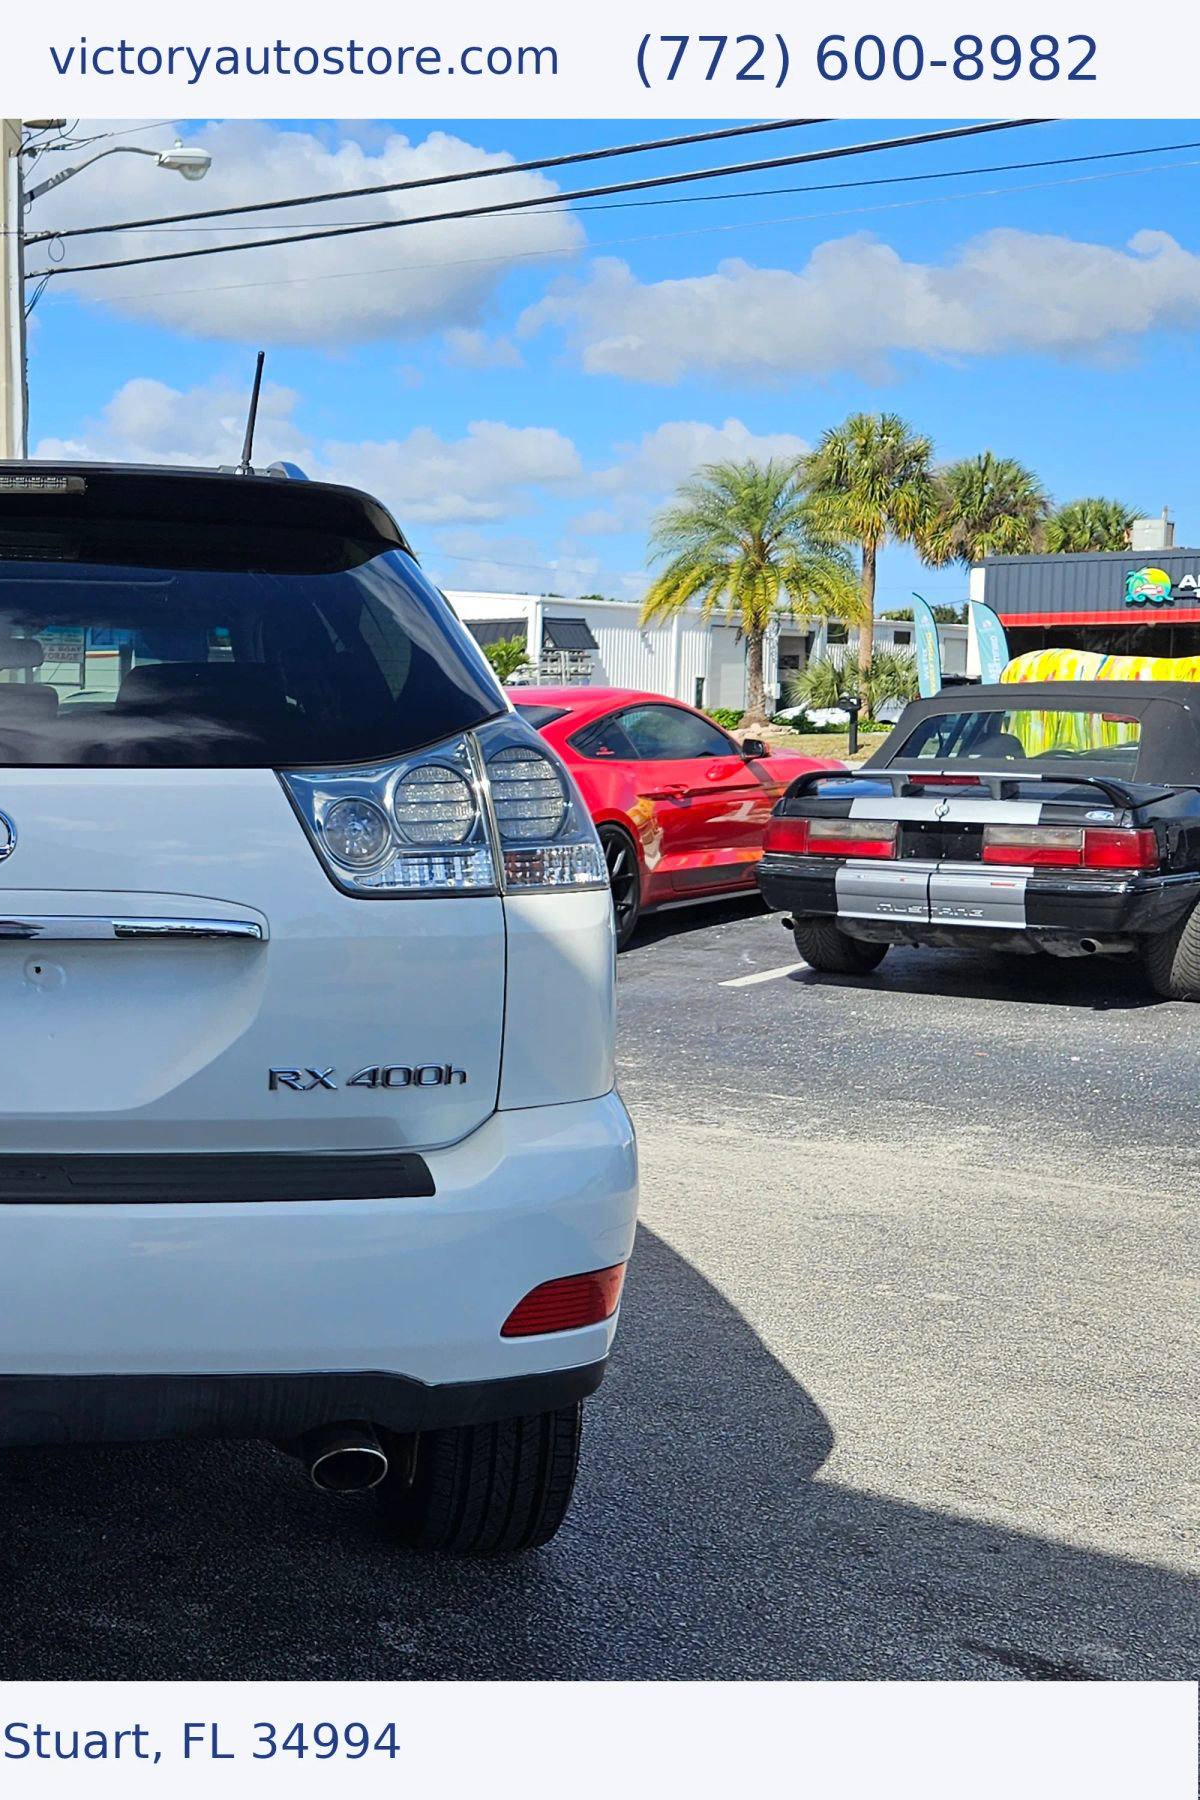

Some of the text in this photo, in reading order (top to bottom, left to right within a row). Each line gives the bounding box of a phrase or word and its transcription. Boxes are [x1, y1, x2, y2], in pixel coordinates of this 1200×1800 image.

[1178, 574, 1200, 589] A
[268, 1063, 467, 1090] RX 400h
